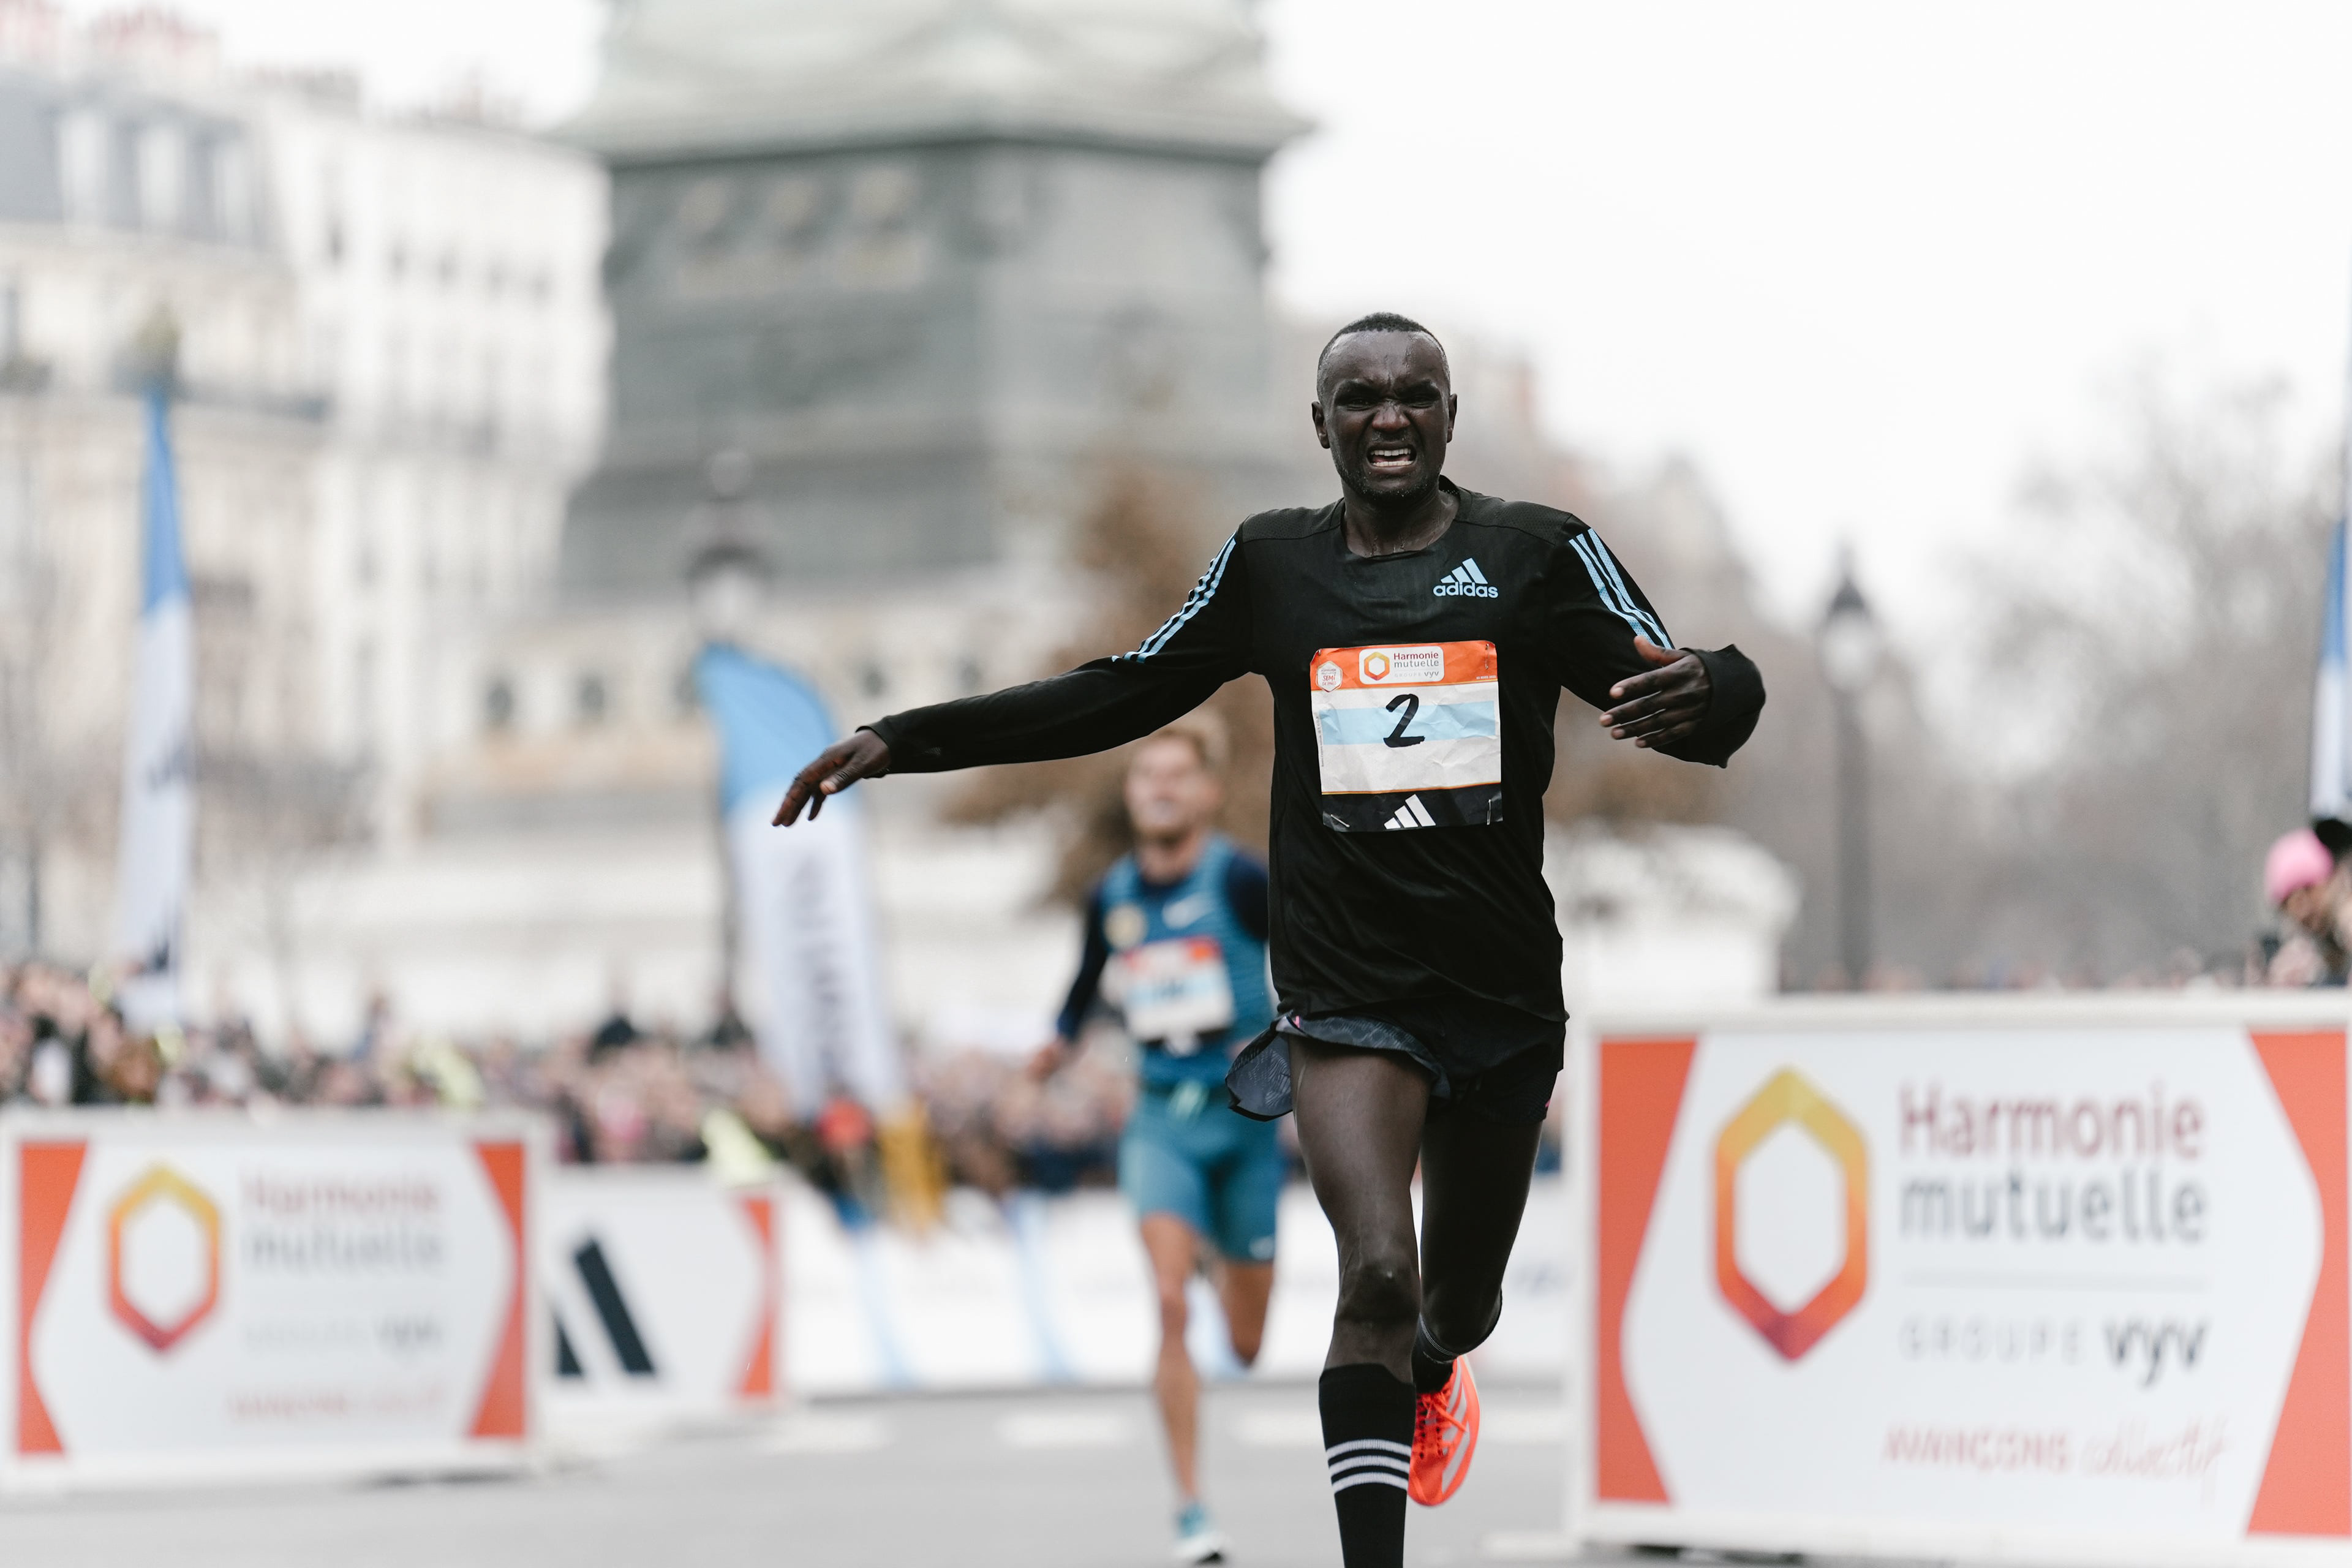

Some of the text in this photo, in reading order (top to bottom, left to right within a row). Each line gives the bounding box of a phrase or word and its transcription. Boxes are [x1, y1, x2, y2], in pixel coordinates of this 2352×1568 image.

[1433, 581, 1499, 598] adidas
[1393, 651, 1439, 660] Harmonie
[1394, 659, 1439, 668] mutuelle
[1383, 693, 1425, 748] 2
[1899, 1082, 2204, 1158] Harmonie
[1900, 1167, 2206, 1242] mutuelle
[1902, 1312, 2212, 1390] GROUPE vyv
